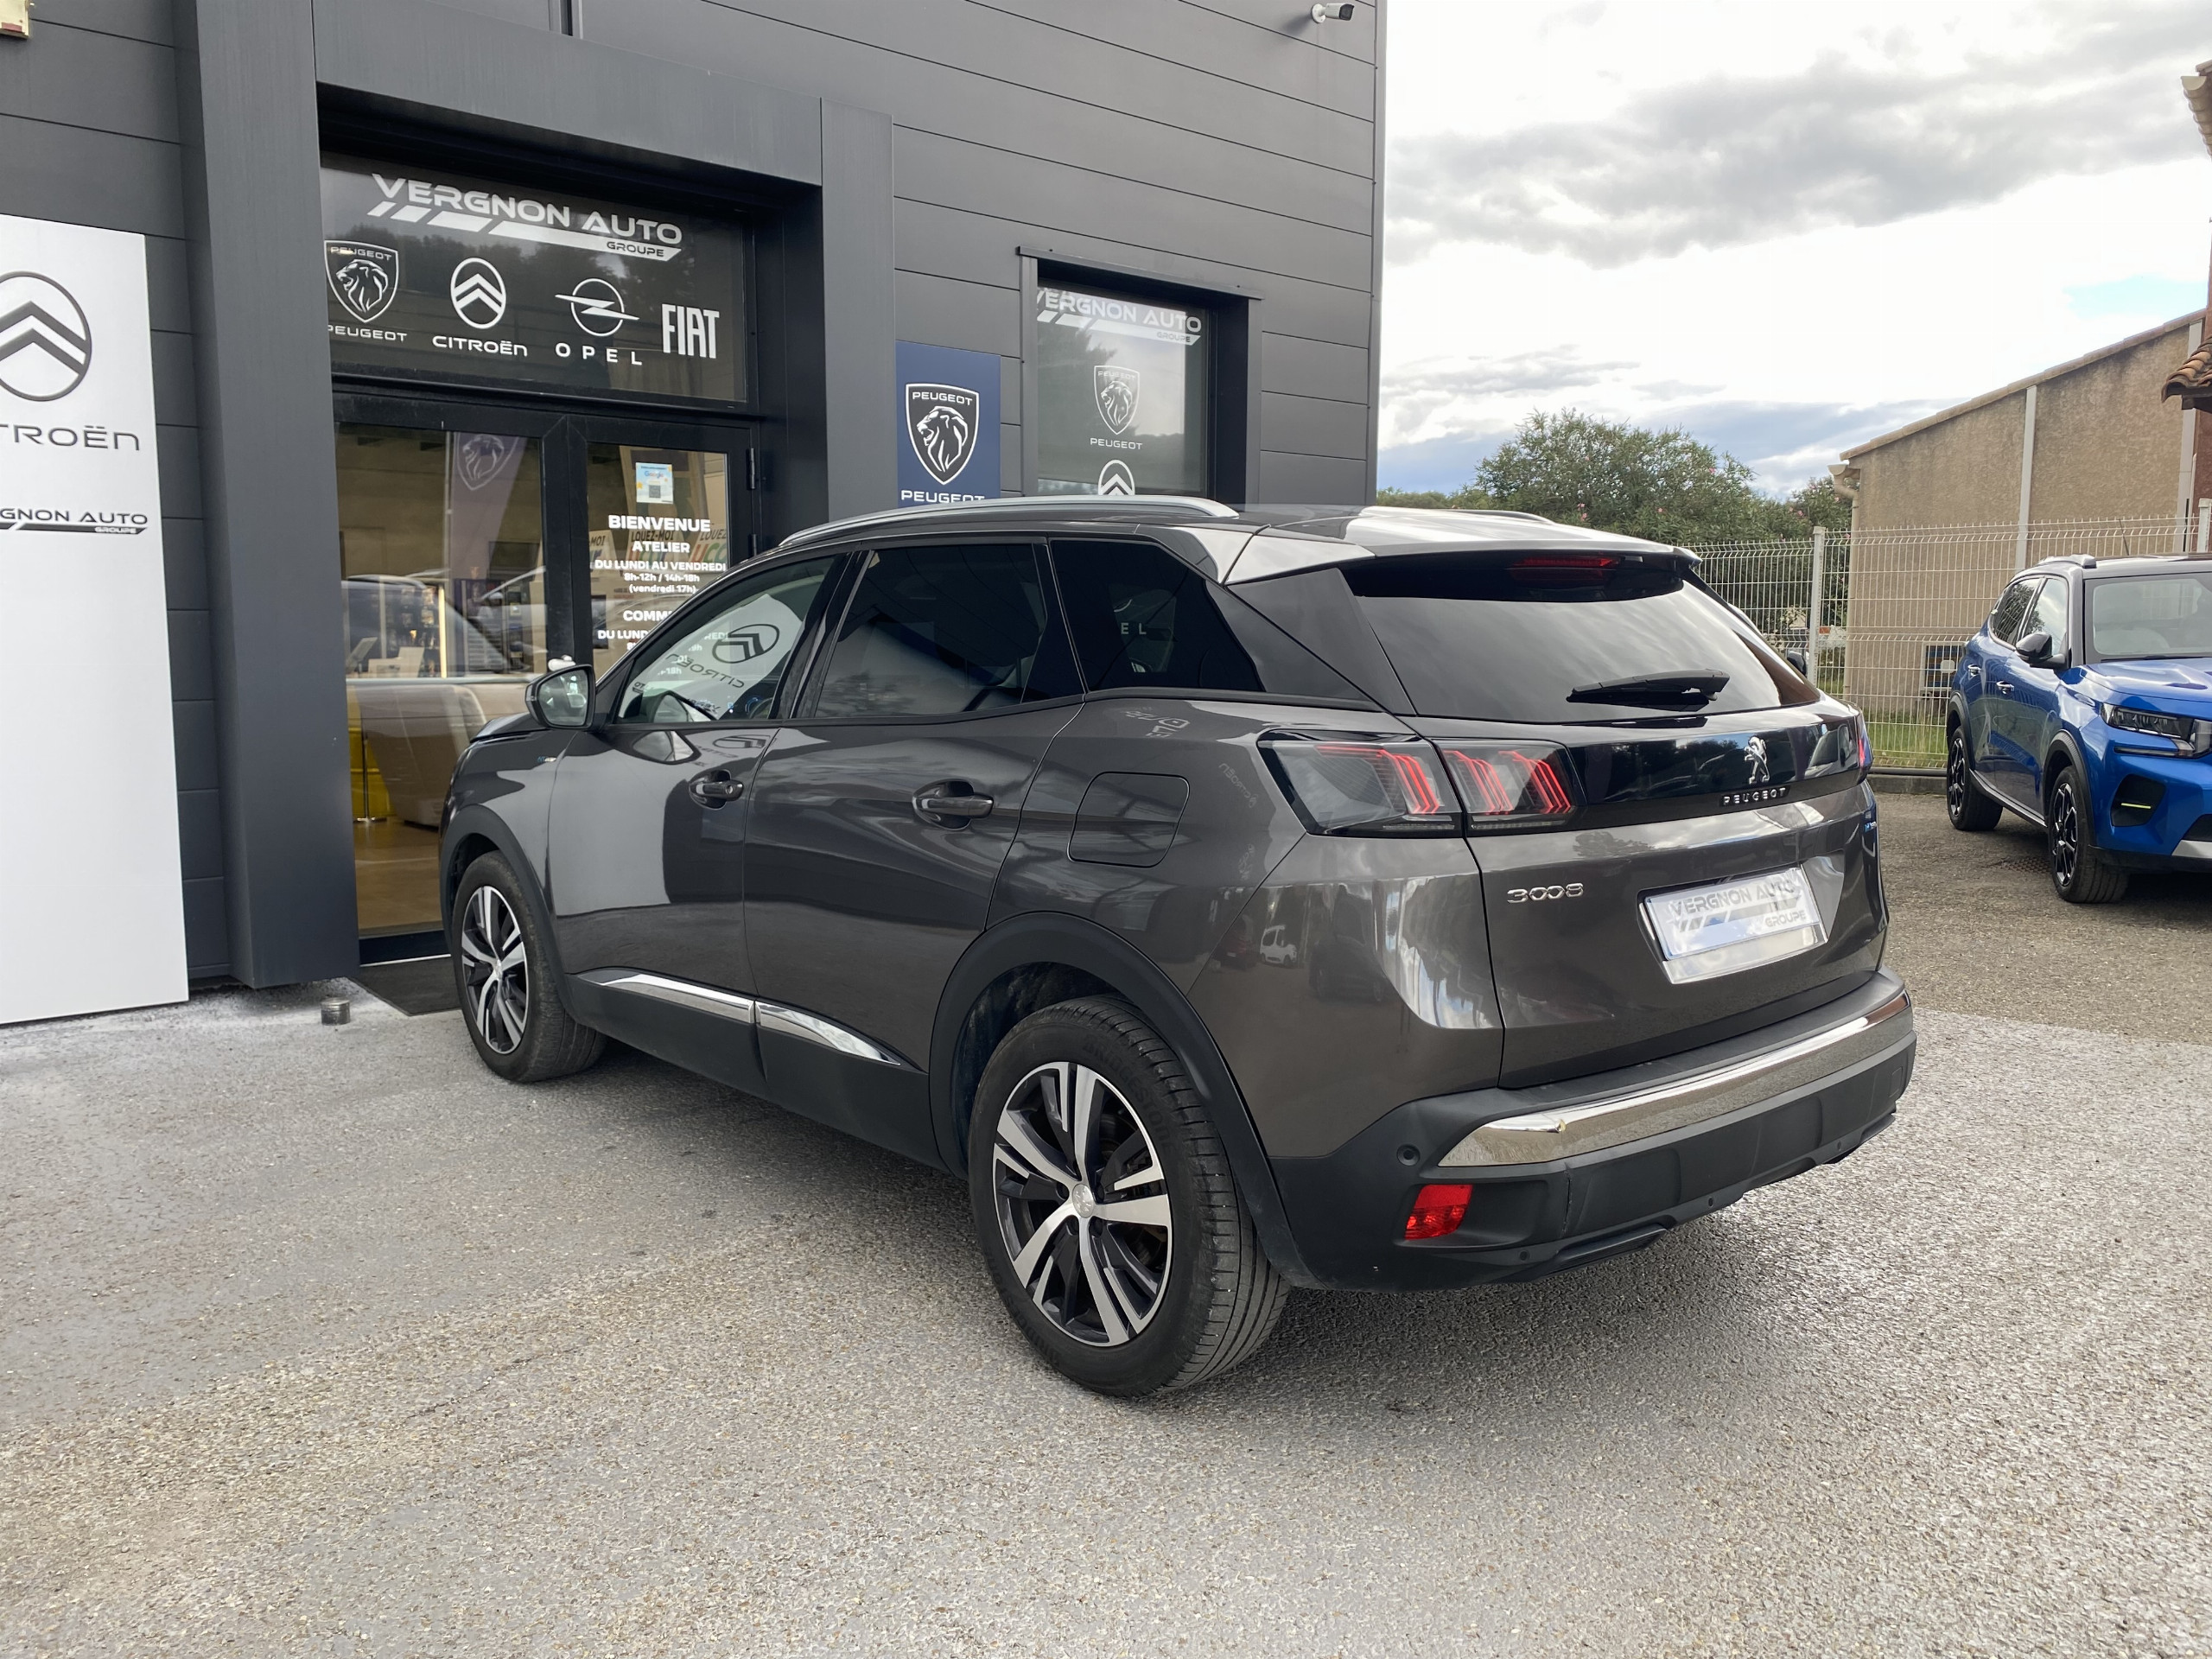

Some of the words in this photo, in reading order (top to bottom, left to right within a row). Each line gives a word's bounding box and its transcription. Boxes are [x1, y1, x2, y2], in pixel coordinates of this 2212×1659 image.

[372, 174, 570, 227] VERGNON
[582, 210, 683, 245] AUTO
[330, 246, 392, 261] PEUGEOT
[607, 240, 664, 257] GROUPE
[1142, 309, 1202, 333] AUTO
[662, 303, 720, 359] FIAT
[1156, 332, 1191, 343] GROUPE
[556, 342, 643, 366] OPEL
[1097, 371, 1136, 381] PEUGEOT
[912, 391, 973, 406] PEUGEOT
[1090, 437, 1143, 450] PEUGEOT
[79, 512, 148, 524] AUTO
[607, 515, 711, 532] BIENVENUE
[632, 541, 690, 553] ATELIER
[594, 560, 613, 569] DU
[614, 560, 650, 569] LUNDI
[652, 561, 669, 570] AU
[671, 563, 727, 571] VENDREDI
[624, 573, 657, 582] 8h-12h
[629, 584, 675, 594] (vendredi
[597, 630, 615, 639] DU
[1723, 787, 1786, 805] PEUGEOT
[1507, 882, 1584, 904] 3008
[1671, 887, 1752, 915] VERGNON
[1764, 910, 1807, 928] GROUPE
